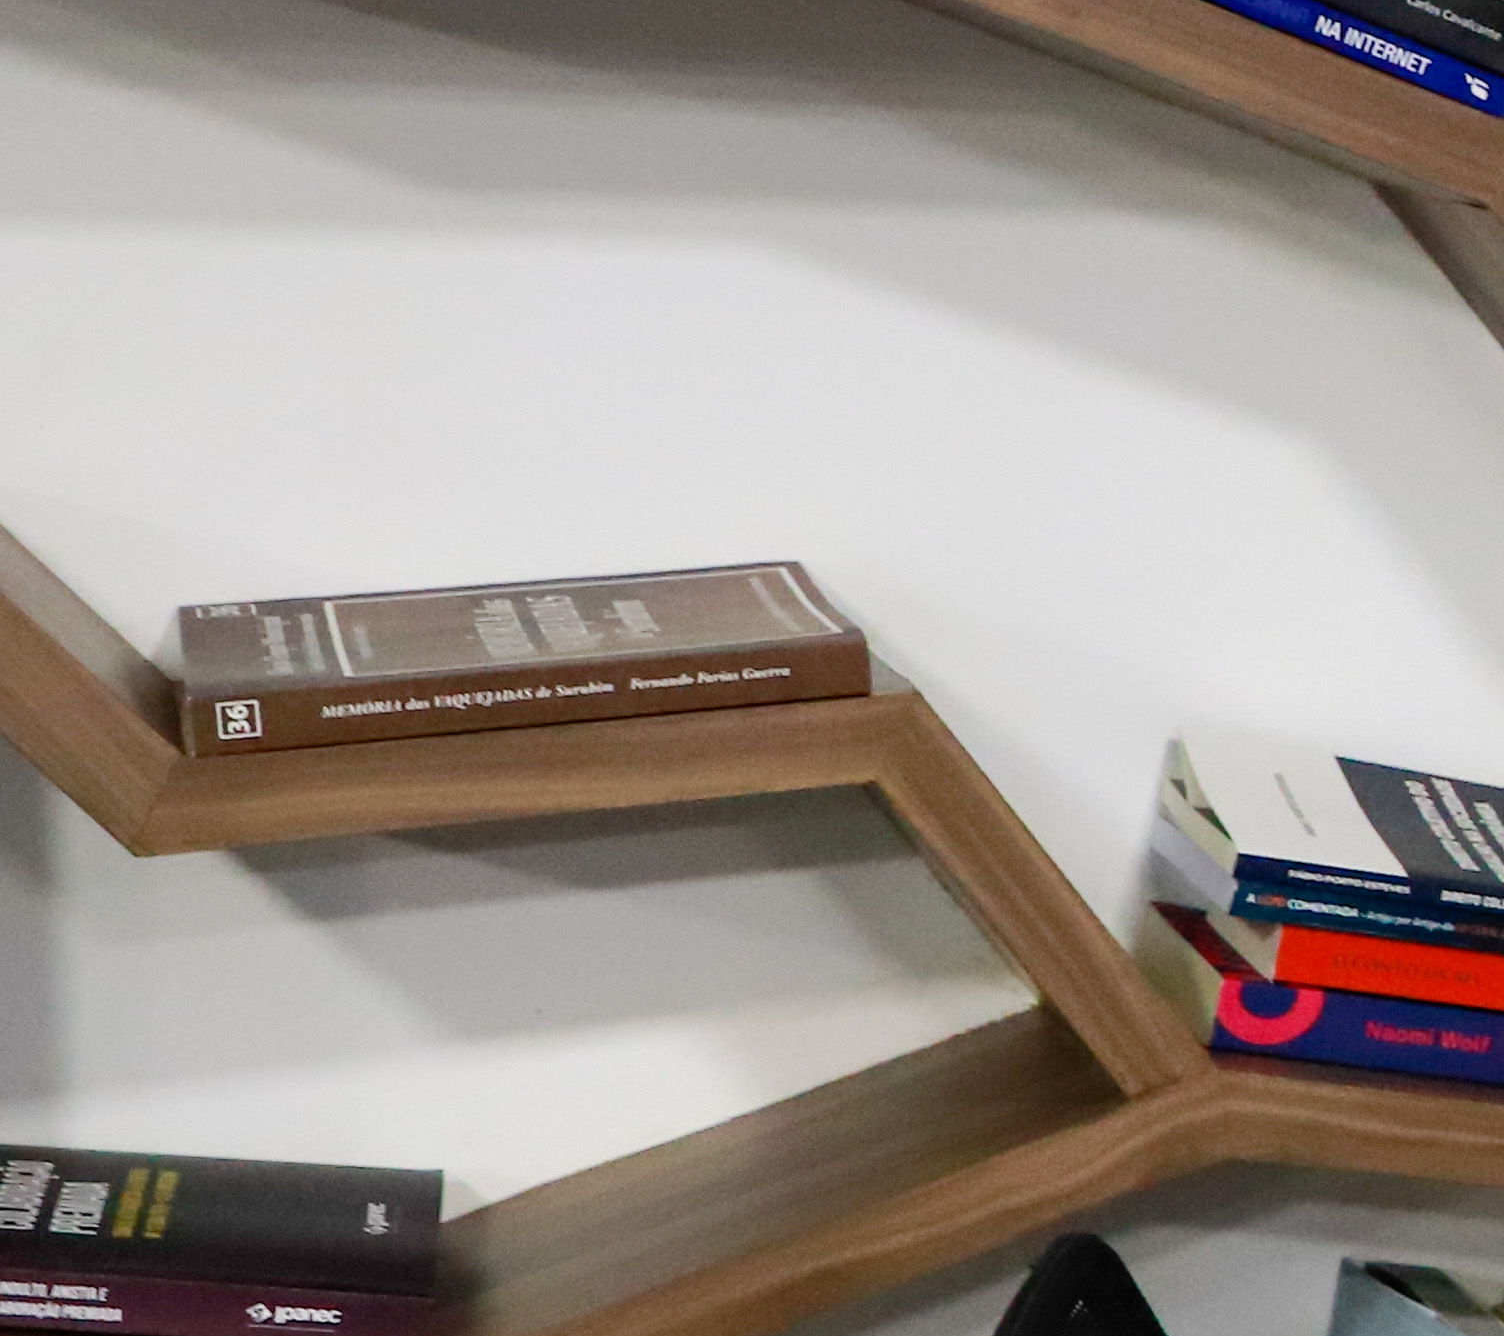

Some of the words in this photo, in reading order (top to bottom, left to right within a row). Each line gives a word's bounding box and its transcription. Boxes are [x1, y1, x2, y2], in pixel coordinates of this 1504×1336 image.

[1314, 14, 1342, 42] NA
[1343, 26, 1433, 76] INTERNET
[320, 699, 403, 719] MEMÓRIA
[404, 697, 431, 711] das
[433, 687, 534, 710] VAQUEJADAS
[534, 685, 553, 699] de
[629, 673, 696, 691] Fernando
[741, 667, 791, 680] Guerra
[228, 703, 250, 734] 36
[1365, 1020, 1436, 1046] Naomi
[1438, 1030, 1491, 1053] Wolf
